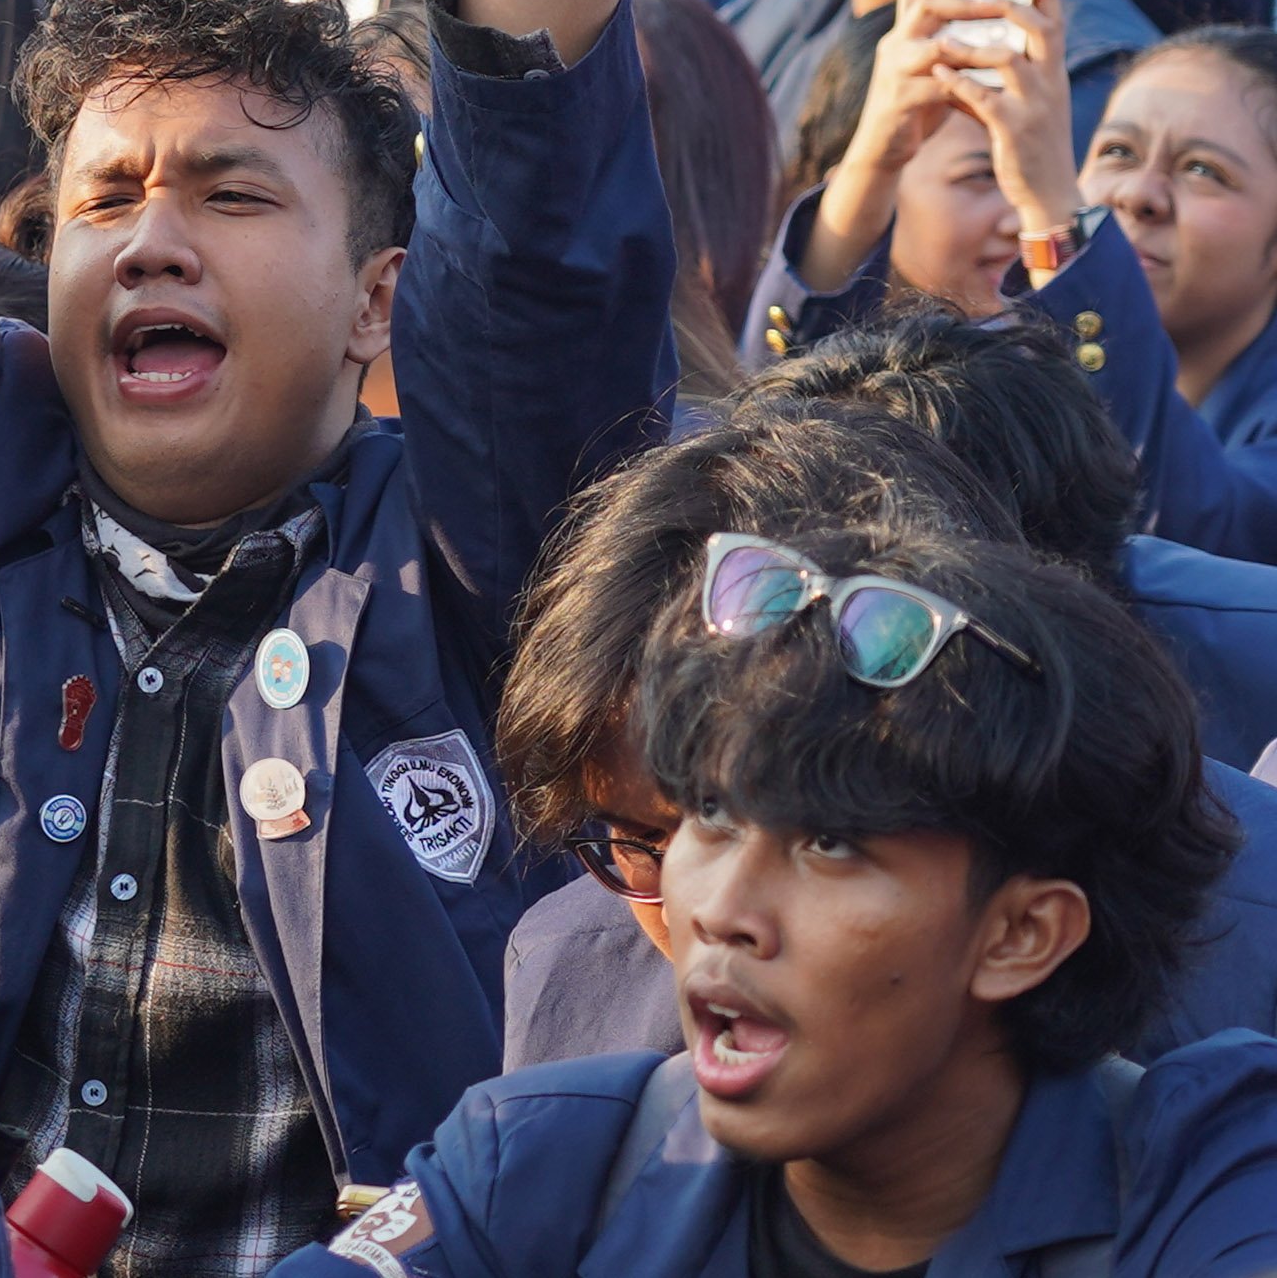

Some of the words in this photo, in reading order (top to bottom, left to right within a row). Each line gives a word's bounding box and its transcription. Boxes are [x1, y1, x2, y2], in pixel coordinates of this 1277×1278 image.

[381, 762, 409, 794] TINGGI
[410, 759, 436, 773] ILMU
[419, 815, 473, 853] TRISAKTI
